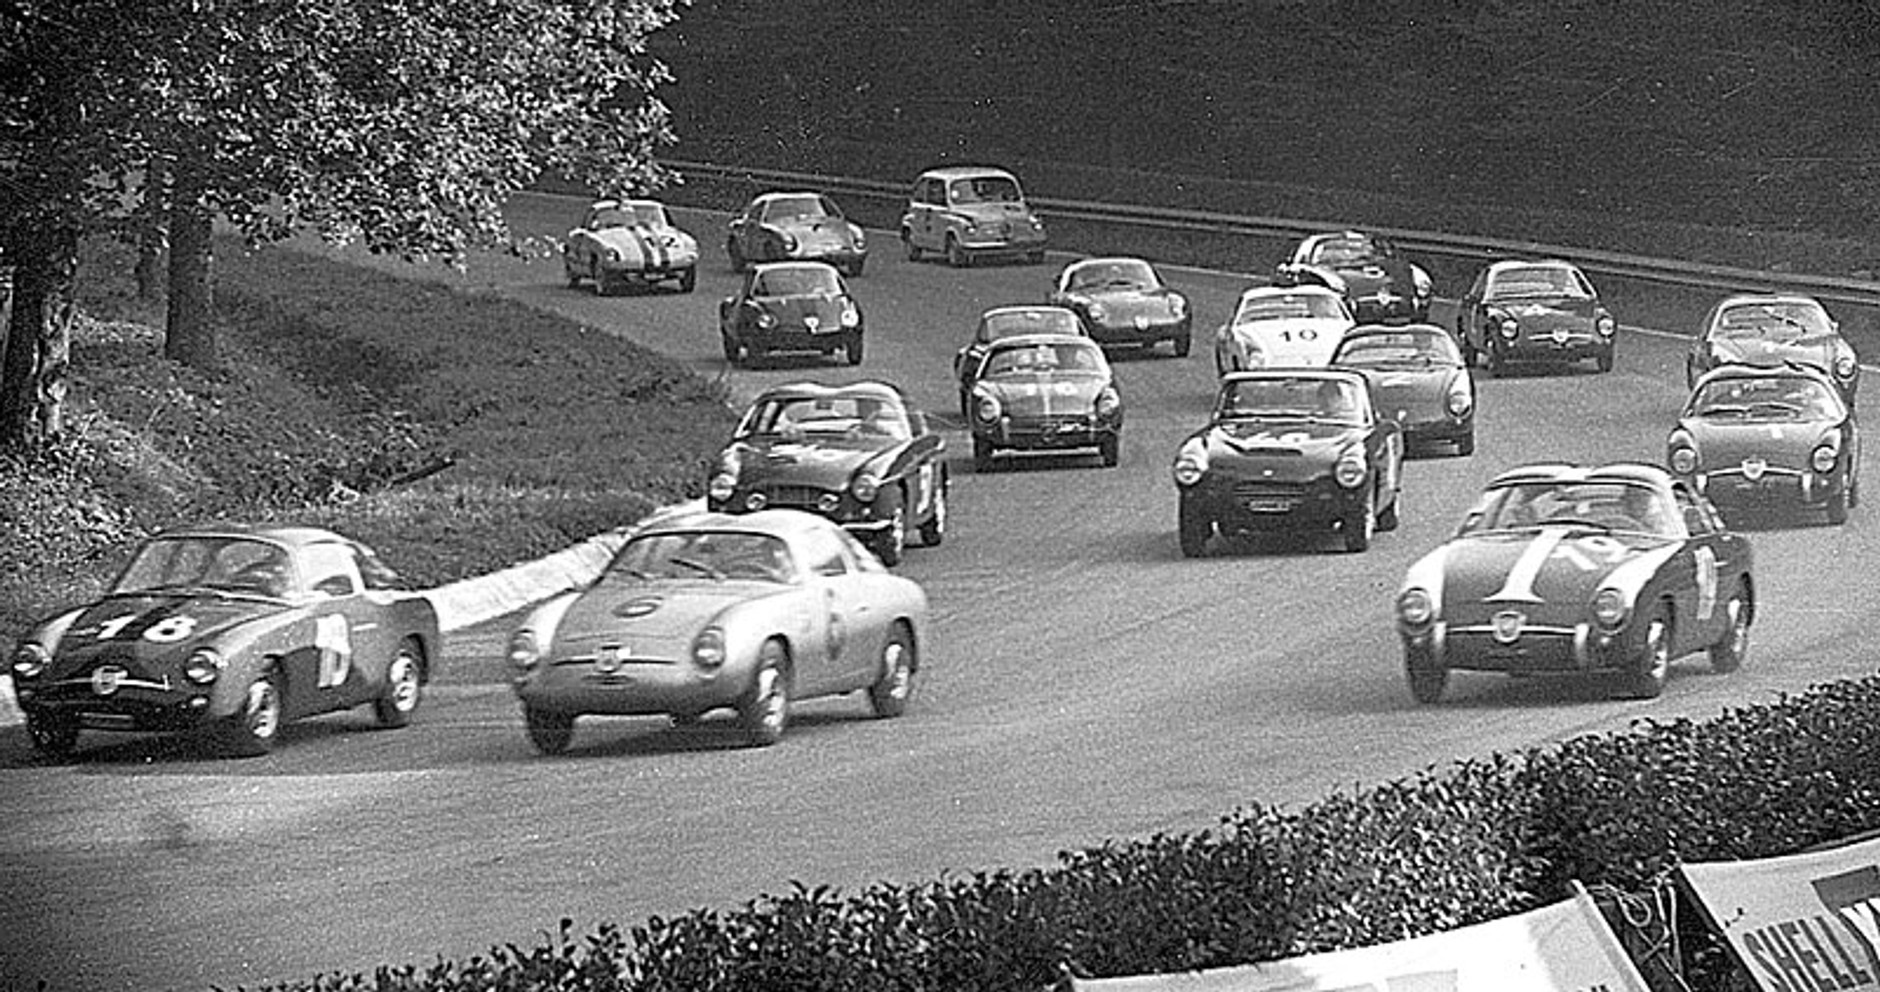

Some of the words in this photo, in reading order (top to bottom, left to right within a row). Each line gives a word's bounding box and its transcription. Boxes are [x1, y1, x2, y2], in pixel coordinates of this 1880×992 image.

[1278, 329, 1318, 342] 10
[97, 615, 197, 642] 18
[1743, 915, 1874, 992] SHELL
